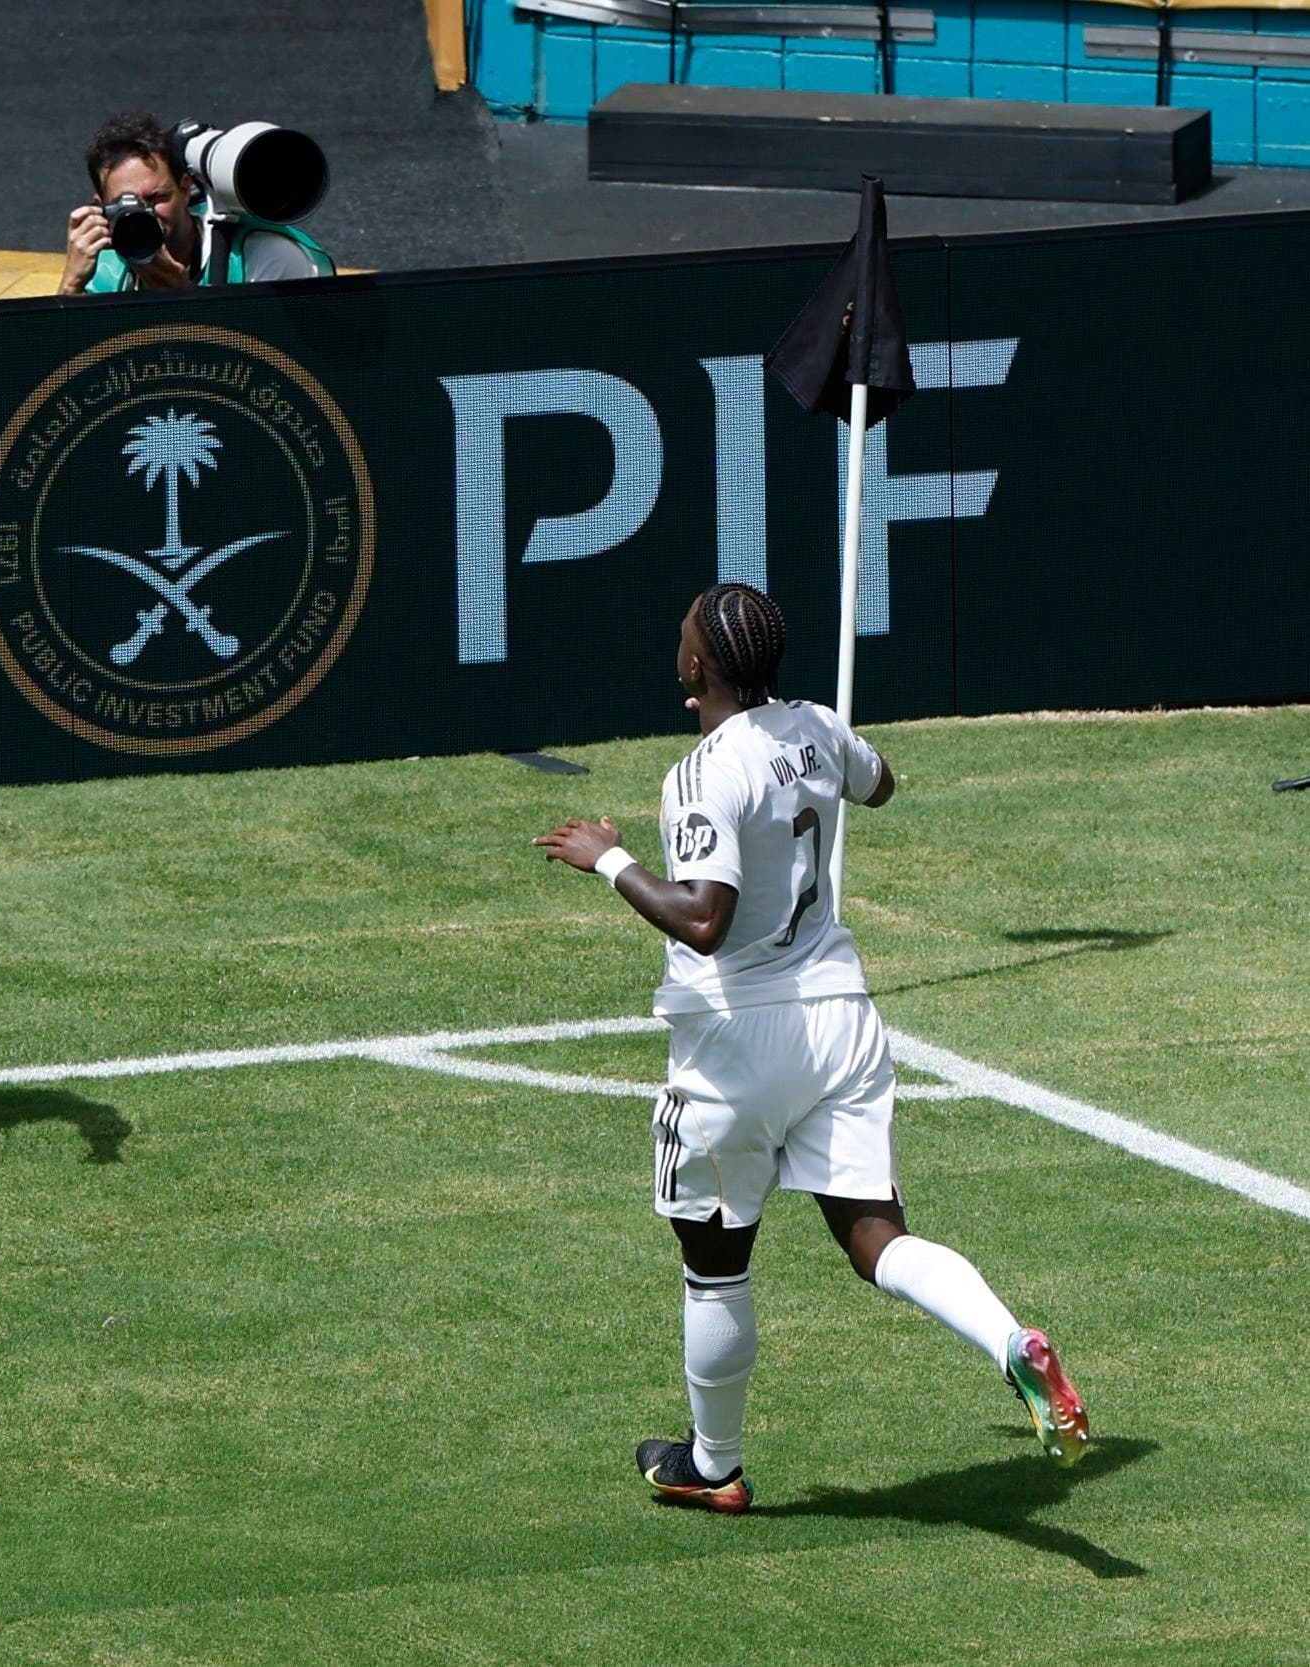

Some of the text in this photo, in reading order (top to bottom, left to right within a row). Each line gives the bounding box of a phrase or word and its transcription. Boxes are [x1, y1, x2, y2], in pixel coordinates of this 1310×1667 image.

[436, 337, 1020, 664] PIF
[10, 590, 336, 728] PUBLIC INVESTMENT FUND
